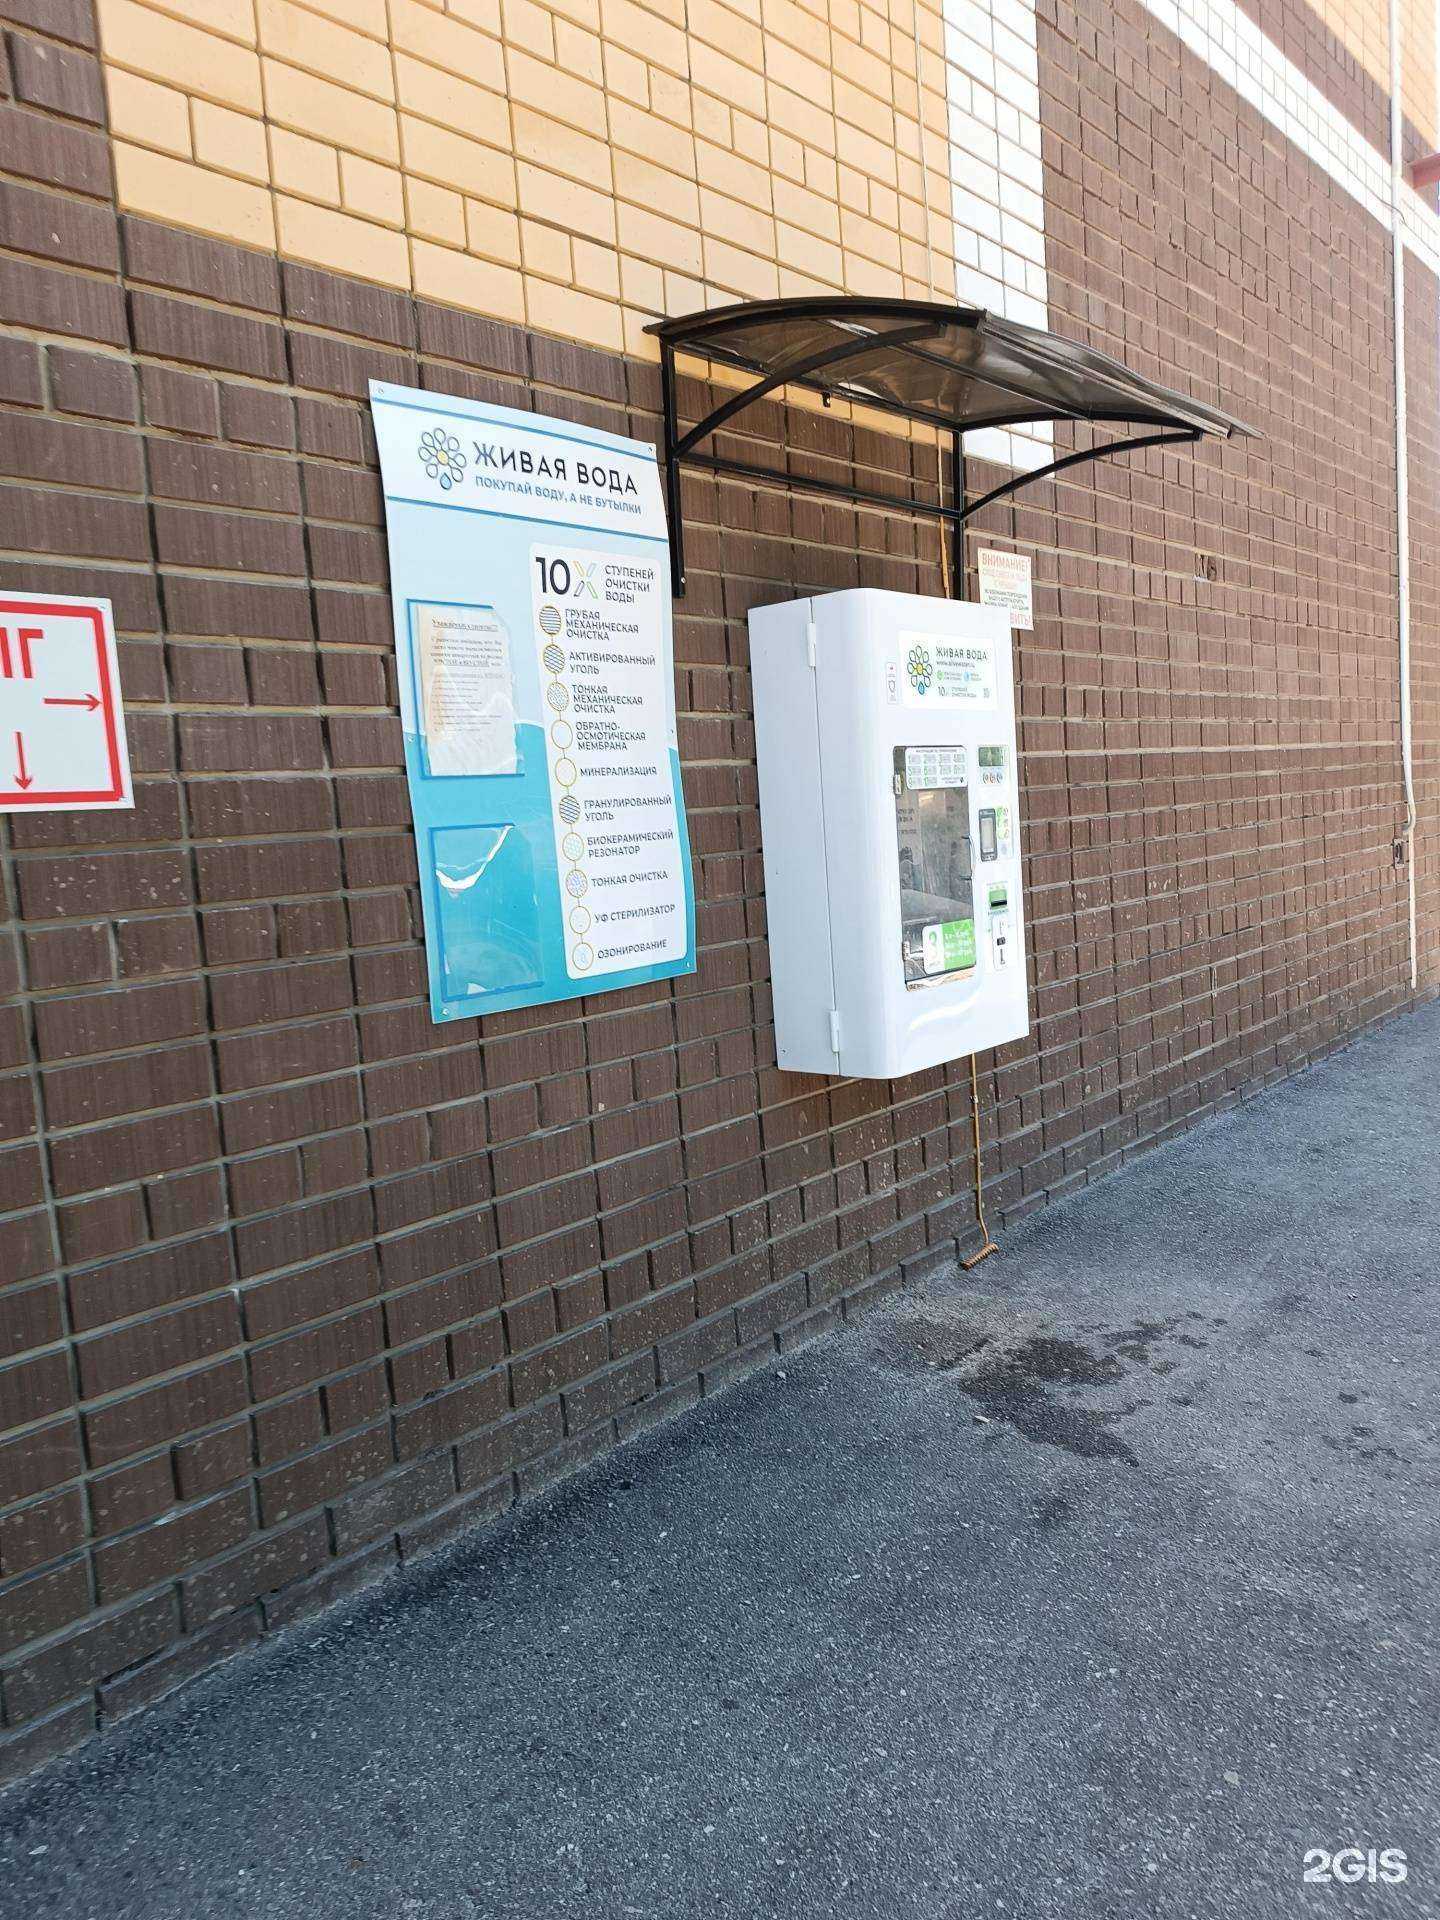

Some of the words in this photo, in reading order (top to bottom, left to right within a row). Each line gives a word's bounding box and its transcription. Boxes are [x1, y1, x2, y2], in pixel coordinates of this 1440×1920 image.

[473, 441, 567, 481] ЖИВАЯ
[577, 462, 638, 495] ВОДА
[475, 475, 533, 495] ПОКУПАЙ
[535, 486, 568, 502] ВОДУ,
[569, 492, 578, 504] А
[579, 494, 593, 506] НЕ
[595, 497, 642, 515] БУТЫЛКИ
[604, 565, 654, 580] СТУПЕНЕЙ
[605, 578, 650, 592] ОЧИСТКИ
[605, 591, 635, 604] ВОДЫ
[565, 608, 601, 620] ГРУБАЯ
[566, 619, 639, 634] МЕХАНИЧЕСКАЯ
[566, 628, 610, 641] ОЧИСТКА
[569, 651, 656, 666] АКТИВИРОВАННЫЙ
[936, 645, 964, 658] ЖИВАЯ
[966, 649, 988, 661] ВОДА
[570, 664, 600, 675] УГОЛЬ
[572, 684, 608, 695] ТОНКАЯ
[573, 694, 643, 705] МЕХАНИЧЕСКАЯ
[574, 704, 616, 714] ОЧИСТКА
[575, 721, 621, 731] ОБРАТНО-
[576, 731, 647, 741] ОСМОТИЧЕСКАЯ
[578, 741, 628, 751] МЕМБРАНА
[580, 766, 657, 777] МИНЕРАЛИЗАЦИЯ
[584, 794, 672, 809] ГРАНУЛИРОВАННЫЙ
[585, 811, 615, 822] УГОЛЬ
[587, 829, 674, 846] БИОКЕРАМИЧЕСКИЙ
[588, 846, 641, 858] РЕЗОНАТОР
[591, 875, 628, 887] ТОНКАЯ
[629, 870, 669, 883] ОЧИСТКА
[595, 913, 609, 923] УФ
[610, 904, 676, 921] СТЕРИЛИЗАТОР
[597, 939, 667, 959] ОЗОНИРОВАНИЕ
